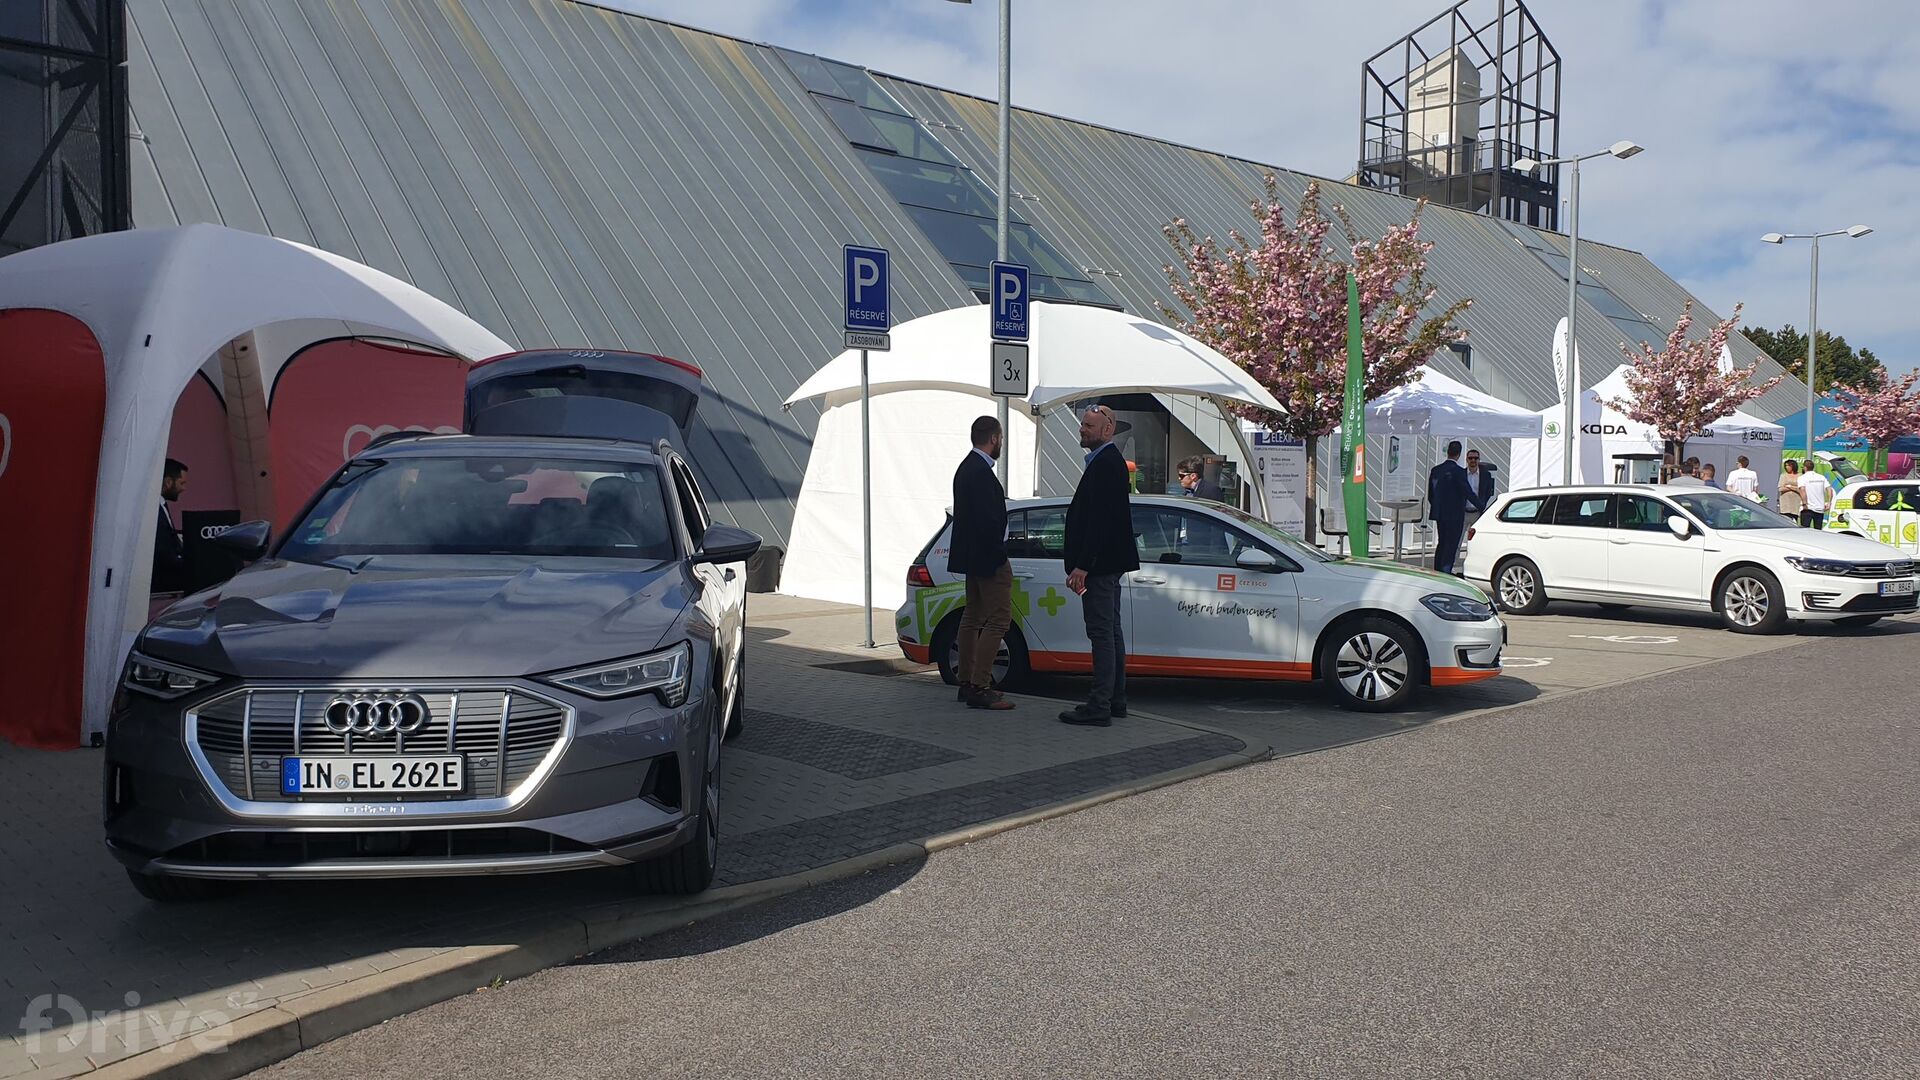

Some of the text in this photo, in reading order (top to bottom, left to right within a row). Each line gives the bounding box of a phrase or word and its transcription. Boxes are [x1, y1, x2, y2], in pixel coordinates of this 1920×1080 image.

[854, 256, 880, 303] P
[1000, 272, 1021, 315] P
[850, 308, 886, 322] RÉSERVÉ
[995, 320, 1025, 332] RÉSERVÉ
[850, 335, 885, 347] ZÁSOBOVÁNÍ
[1003, 358, 1020, 382] 3x
[1580, 424, 1627, 435] KODA
[1750, 428, 1773, 441] ŠKODA
[302, 762, 458, 788] IN EL 262E
[289, 778, 295, 786] D
